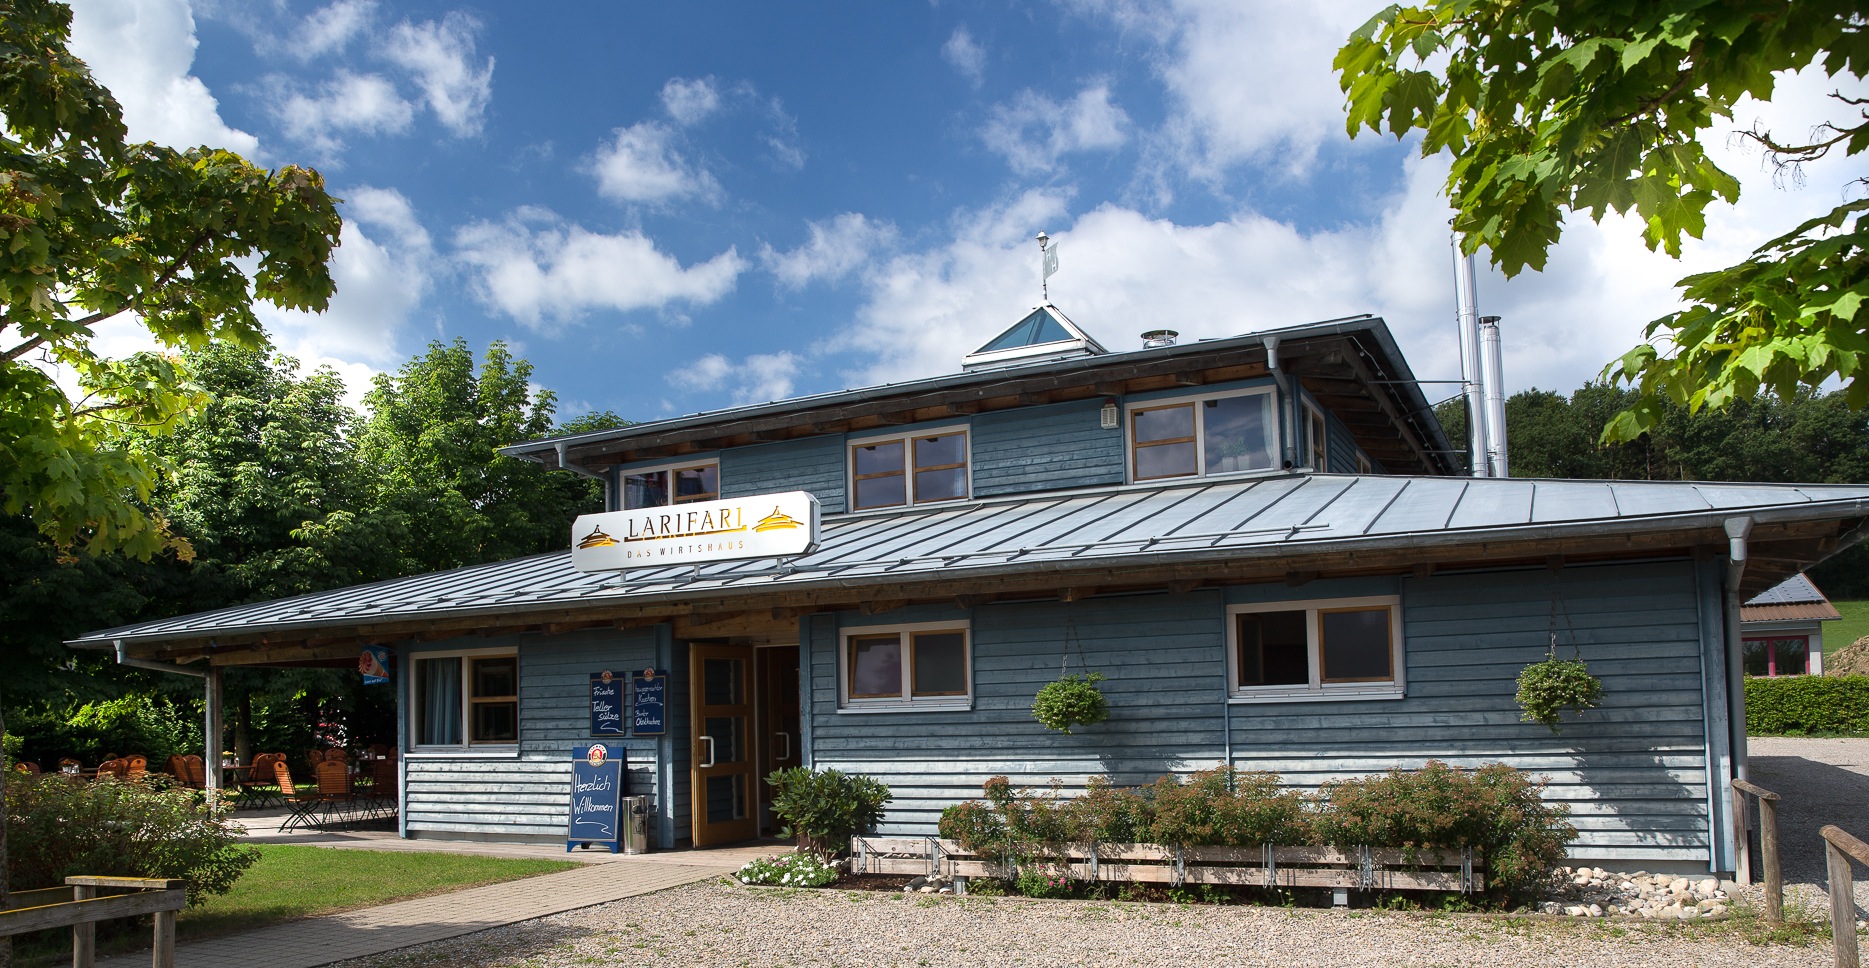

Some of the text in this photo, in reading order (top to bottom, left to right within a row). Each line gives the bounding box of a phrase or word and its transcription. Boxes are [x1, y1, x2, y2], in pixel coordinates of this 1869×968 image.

[629, 507, 741, 538] LARIFARI
[627, 540, 744, 559] DAS WIRTSHAUS
[592, 701, 613, 713] Teller
[574, 773, 611, 794] Herzlich
[573, 797, 613, 815] Willkommen
